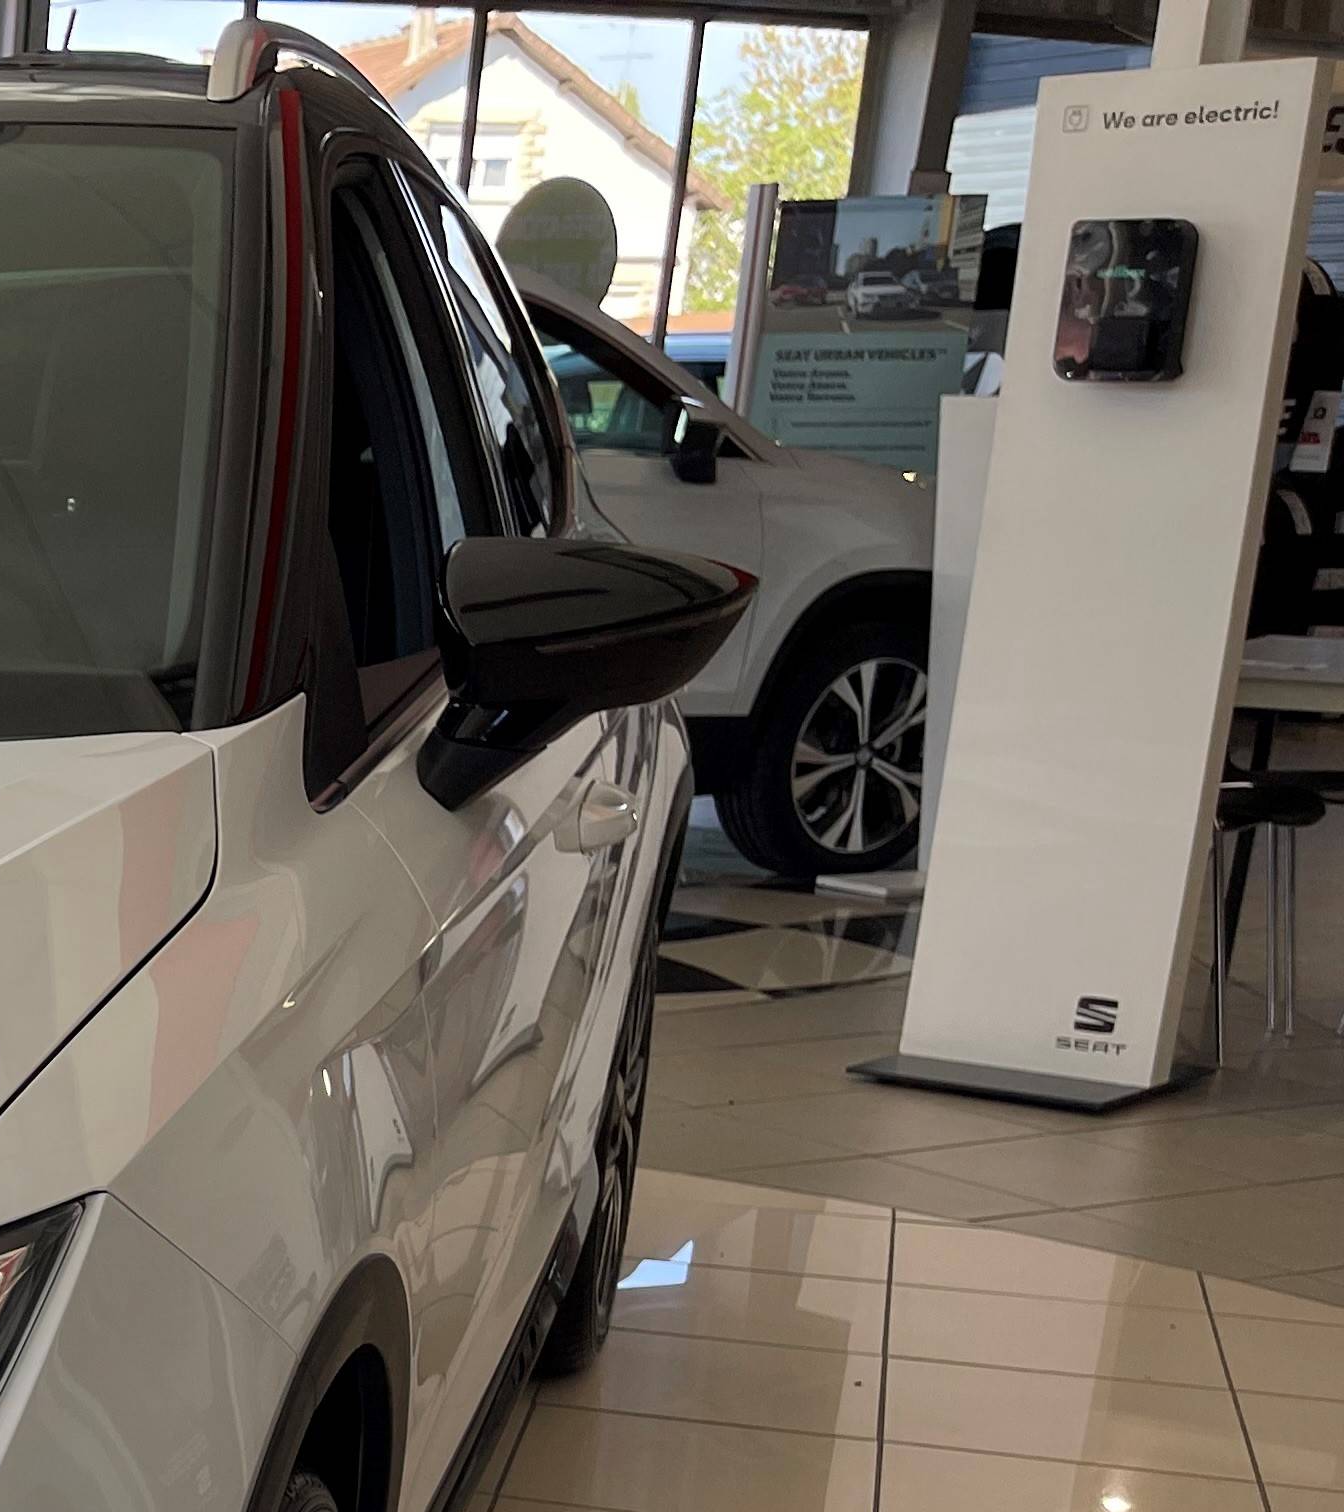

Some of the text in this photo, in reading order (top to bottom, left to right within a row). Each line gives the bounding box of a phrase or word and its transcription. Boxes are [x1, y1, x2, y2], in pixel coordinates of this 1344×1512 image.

[1103, 99, 1280, 130] We are electric!
[1055, 1036, 1127, 1057] SEAT
